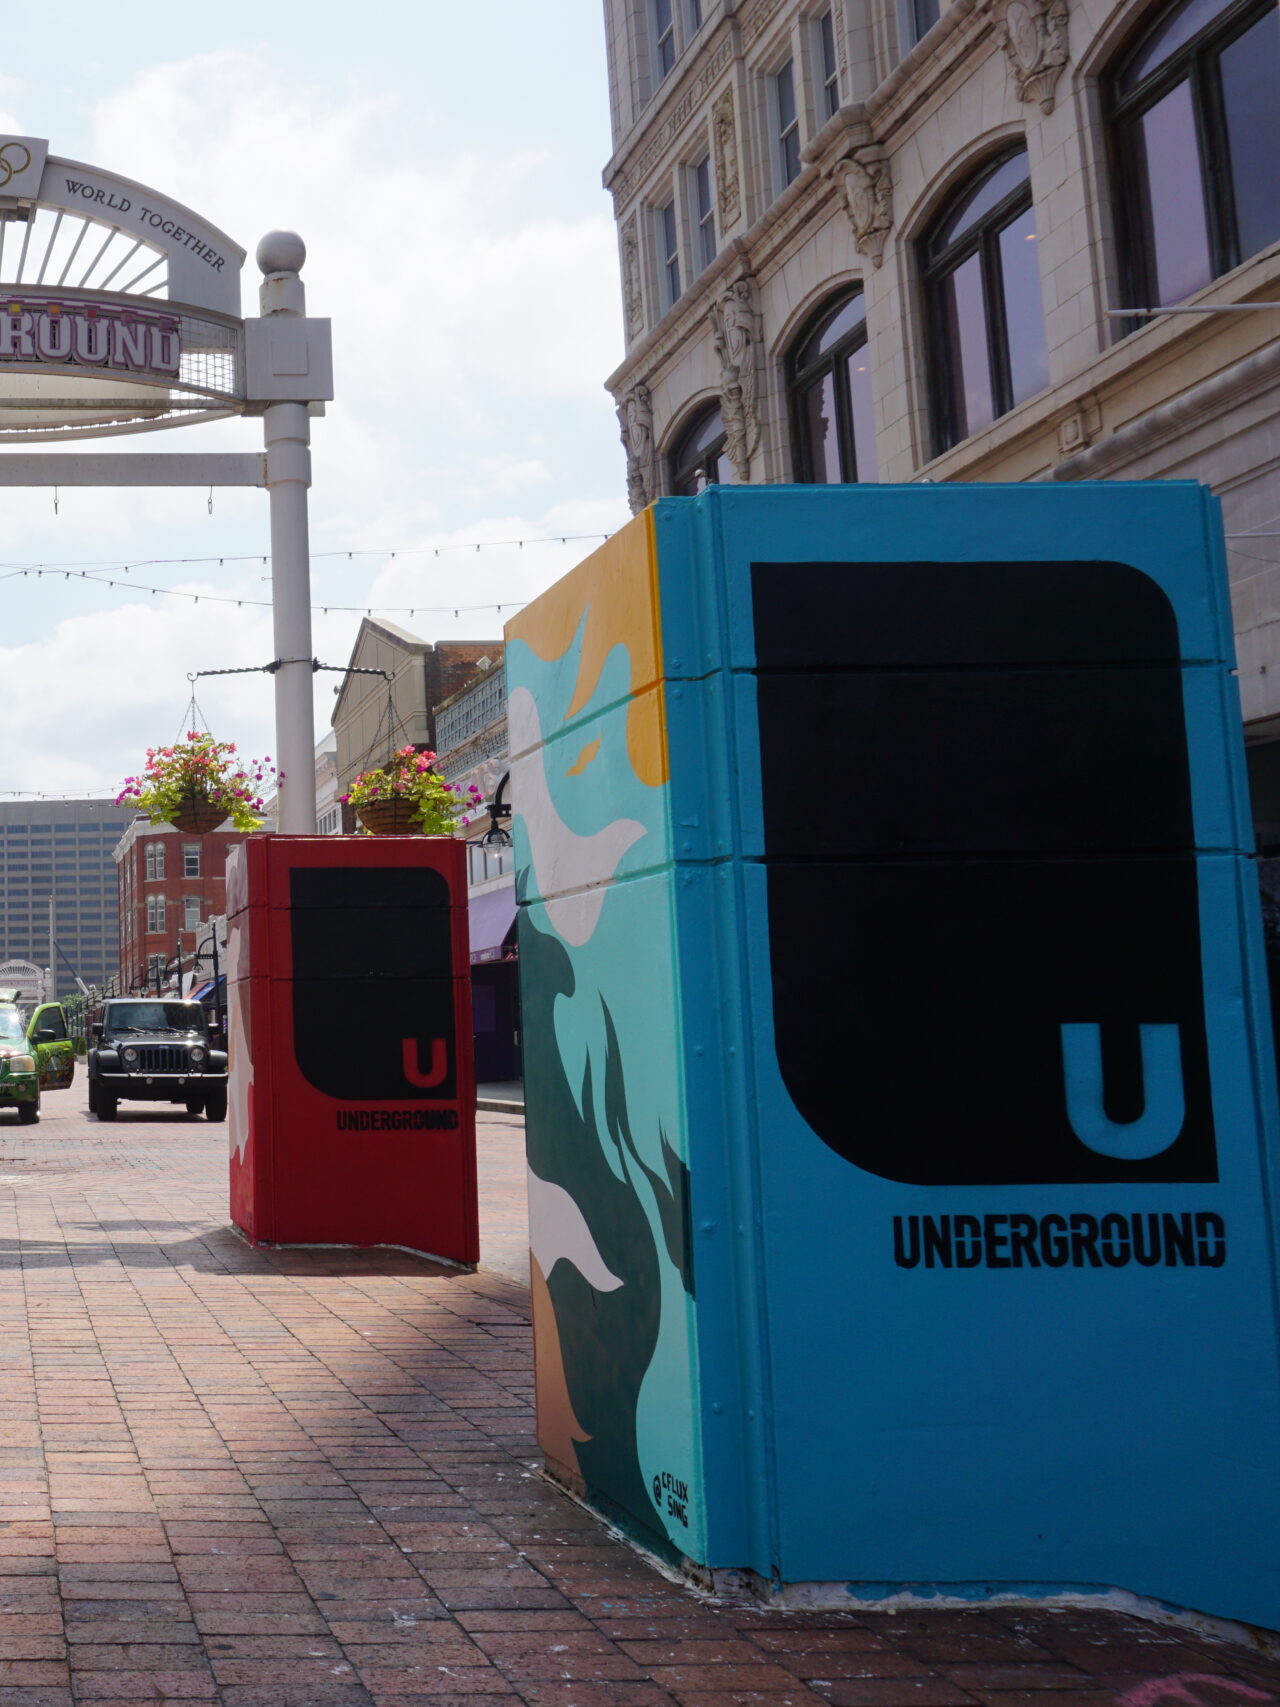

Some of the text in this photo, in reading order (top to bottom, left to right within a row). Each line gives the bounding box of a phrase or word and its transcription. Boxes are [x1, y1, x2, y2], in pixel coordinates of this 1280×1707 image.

[65, 179, 225, 272] WORLD TOGETHER
[402, 1038, 447, 1089] U
[1061, 1022, 1186, 1160] U
[337, 1109, 458, 1131] UNDERGROUND
[892, 1211, 1227, 1269] UNDERGROUND
